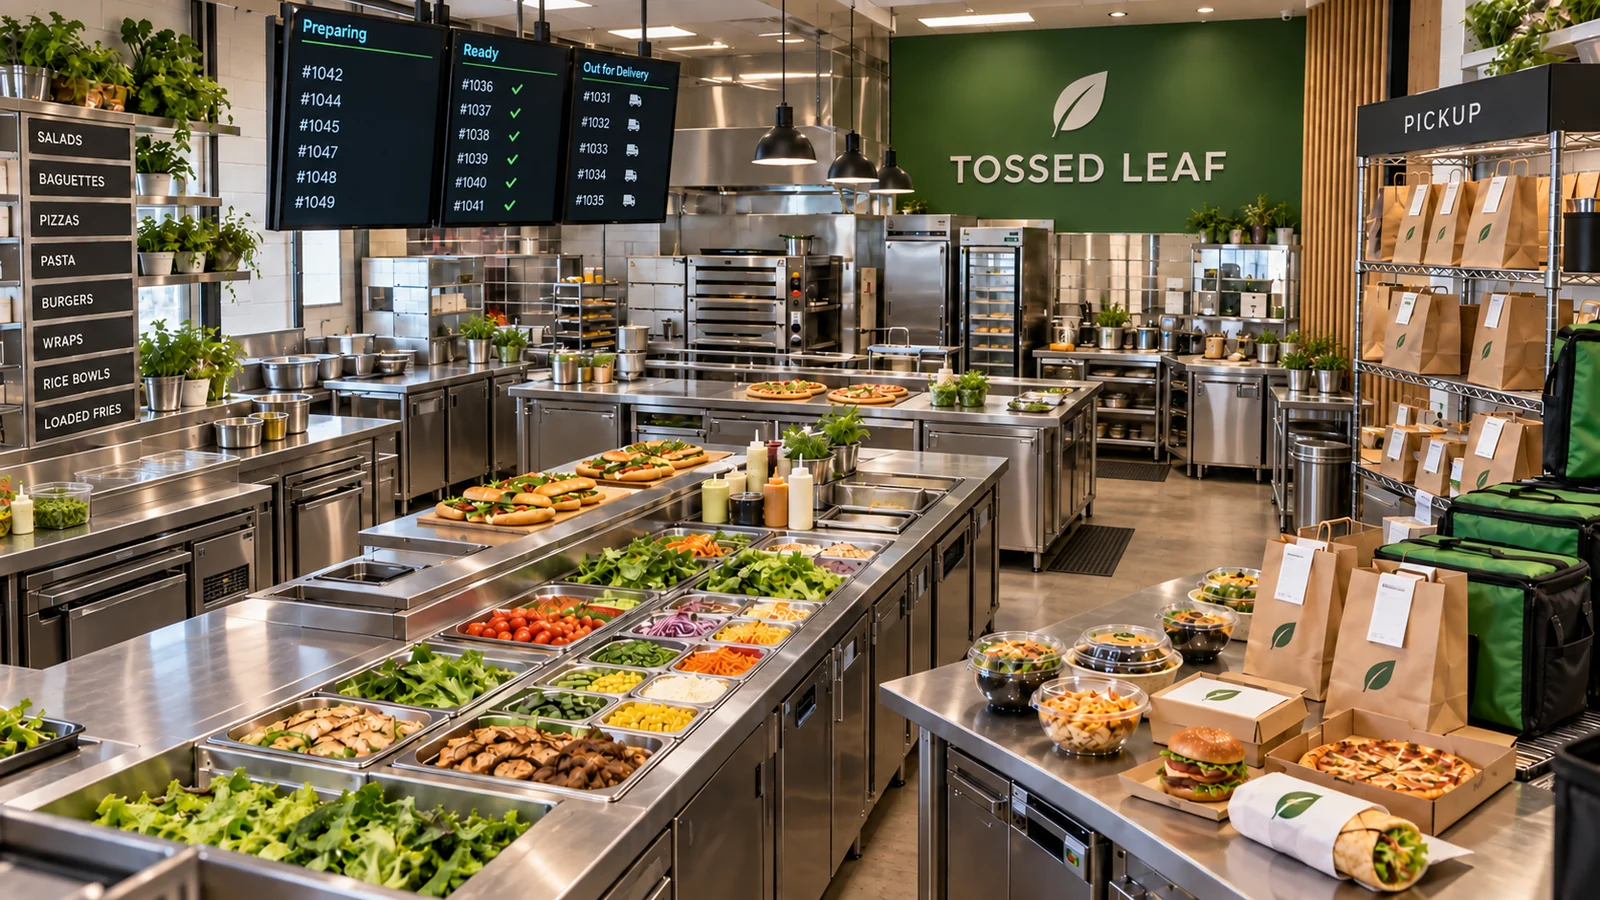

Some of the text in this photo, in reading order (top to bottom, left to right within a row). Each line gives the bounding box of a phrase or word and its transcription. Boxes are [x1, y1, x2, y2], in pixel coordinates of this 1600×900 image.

[302, 19, 367, 44] Preparing
[464, 44, 499, 62] Ready
[302, 65, 343, 82] #1042
[584, 62, 649, 82] Out for Delivery
[462, 79, 493, 93] #1036
[301, 93, 341, 108] #1044
[584, 92, 610, 104] #1031
[460, 104, 491, 117] #1037
[582, 117, 609, 129] #1032
[1405, 103, 1481, 133] PICKUP
[299, 119, 339, 134] #1045
[38, 131, 82, 145] SALADS
[459, 128, 489, 141] #1038
[298, 145, 338, 159] #1047
[580, 143, 608, 155] #1033
[457, 153, 488, 165] #1039
[950, 151, 1227, 183] TOSSED LEAF
[40, 173, 105, 187] BAGUETTES
[297, 171, 336, 184] #1048
[578, 169, 606, 181] #1034
[456, 177, 486, 189] #1040
[295, 196, 335, 209] #1049
[454, 200, 483, 212] #1041
[576, 195, 604, 206] #1035
[40, 215, 79, 225] PIZZAS
[41, 255, 75, 266] PASTA
[42, 294, 93, 308] BURGERS
[43, 334, 83, 348] WRAPS
[43, 368, 111, 390] RICE BOWLS
[44, 403, 122, 430] LOADED FRIES
